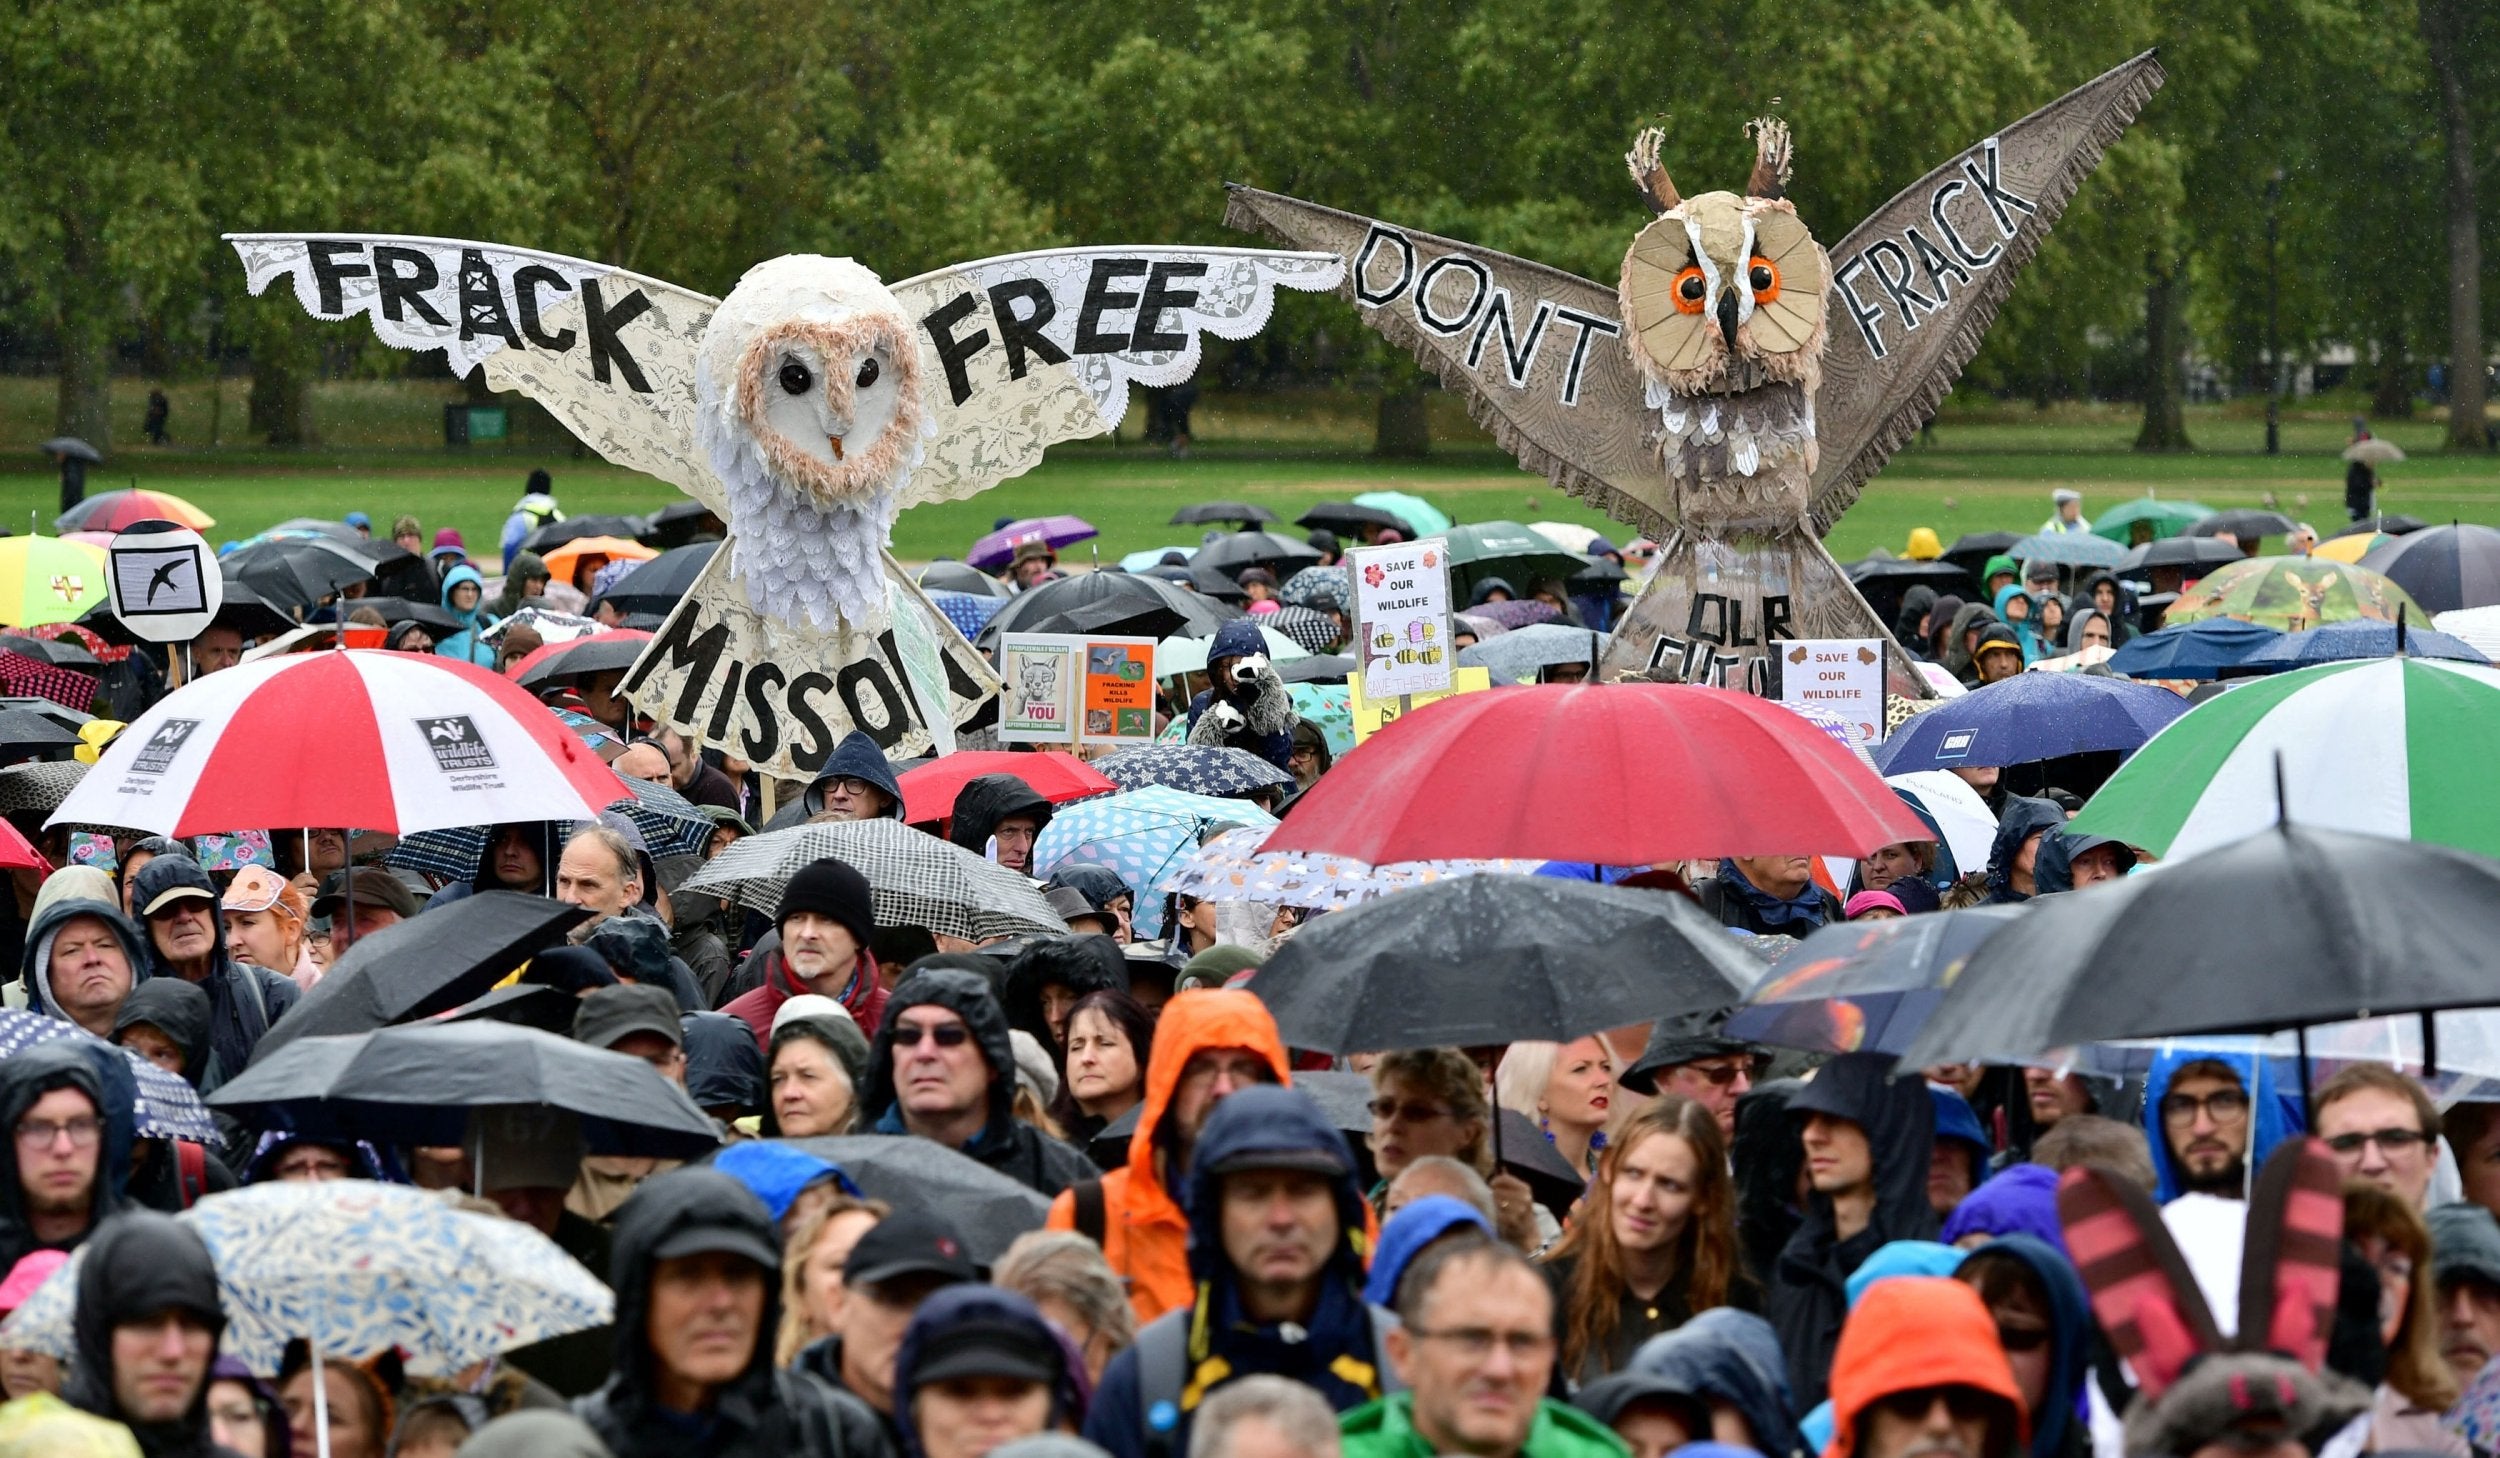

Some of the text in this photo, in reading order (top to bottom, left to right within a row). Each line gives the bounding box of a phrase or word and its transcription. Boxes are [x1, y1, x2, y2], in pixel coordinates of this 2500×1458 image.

[1832, 137, 2036, 360] FRACK
[1353, 222, 1624, 408] DONT
[306, 240, 1209, 406] FRACK FREE
[1386, 560, 1415, 572] SAVE
[1390, 579, 1414, 590] OUR
[1377, 597, 1429, 611] WILDLIFE
[1815, 653, 1849, 663] SAVE
[1818, 671, 1846, 681] OUR
[1367, 672, 1447, 696] SAVE THE BEES
[1803, 689, 1862, 699] WILDLIFE
[1027, 706, 1056, 720] YOU
[436, 741, 487, 759] wildlife
[134, 761, 167, 771] TRUSTS
[440, 757, 493, 769] TRUSTS
[451, 783, 482, 791] Wildlife
